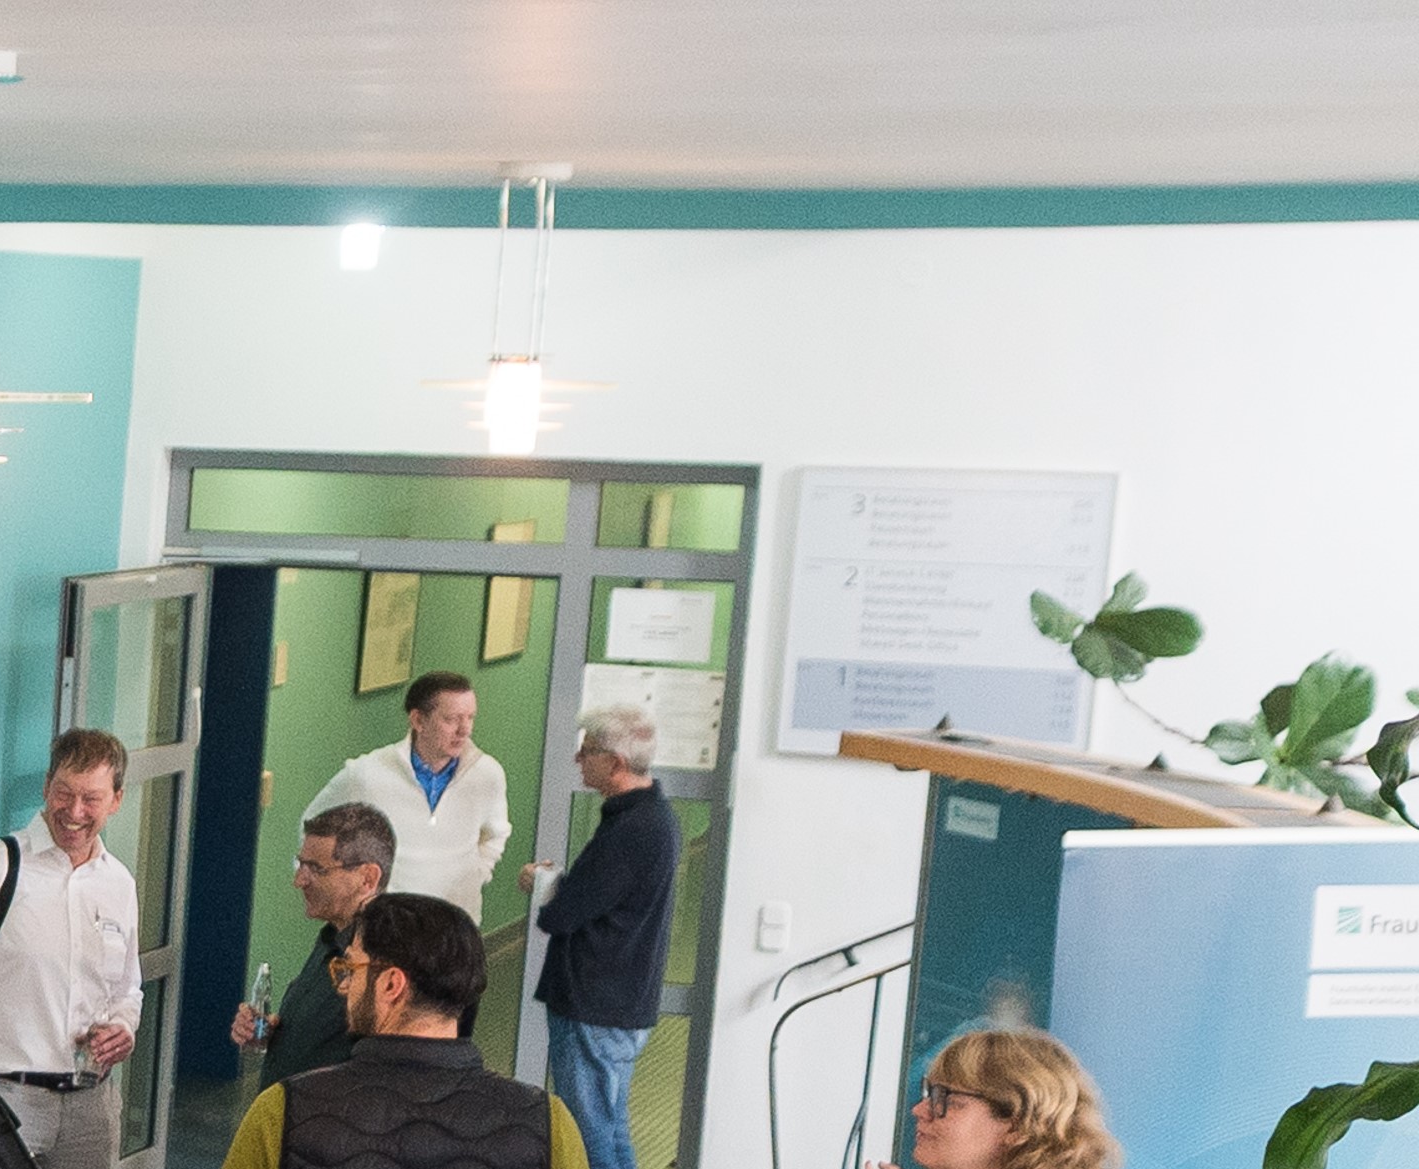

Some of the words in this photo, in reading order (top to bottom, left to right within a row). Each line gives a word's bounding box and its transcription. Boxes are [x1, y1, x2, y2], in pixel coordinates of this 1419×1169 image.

[852, 493, 866, 514] 3
[844, 566, 858, 587] 2
[1370, 915, 1419, 934] Frau
